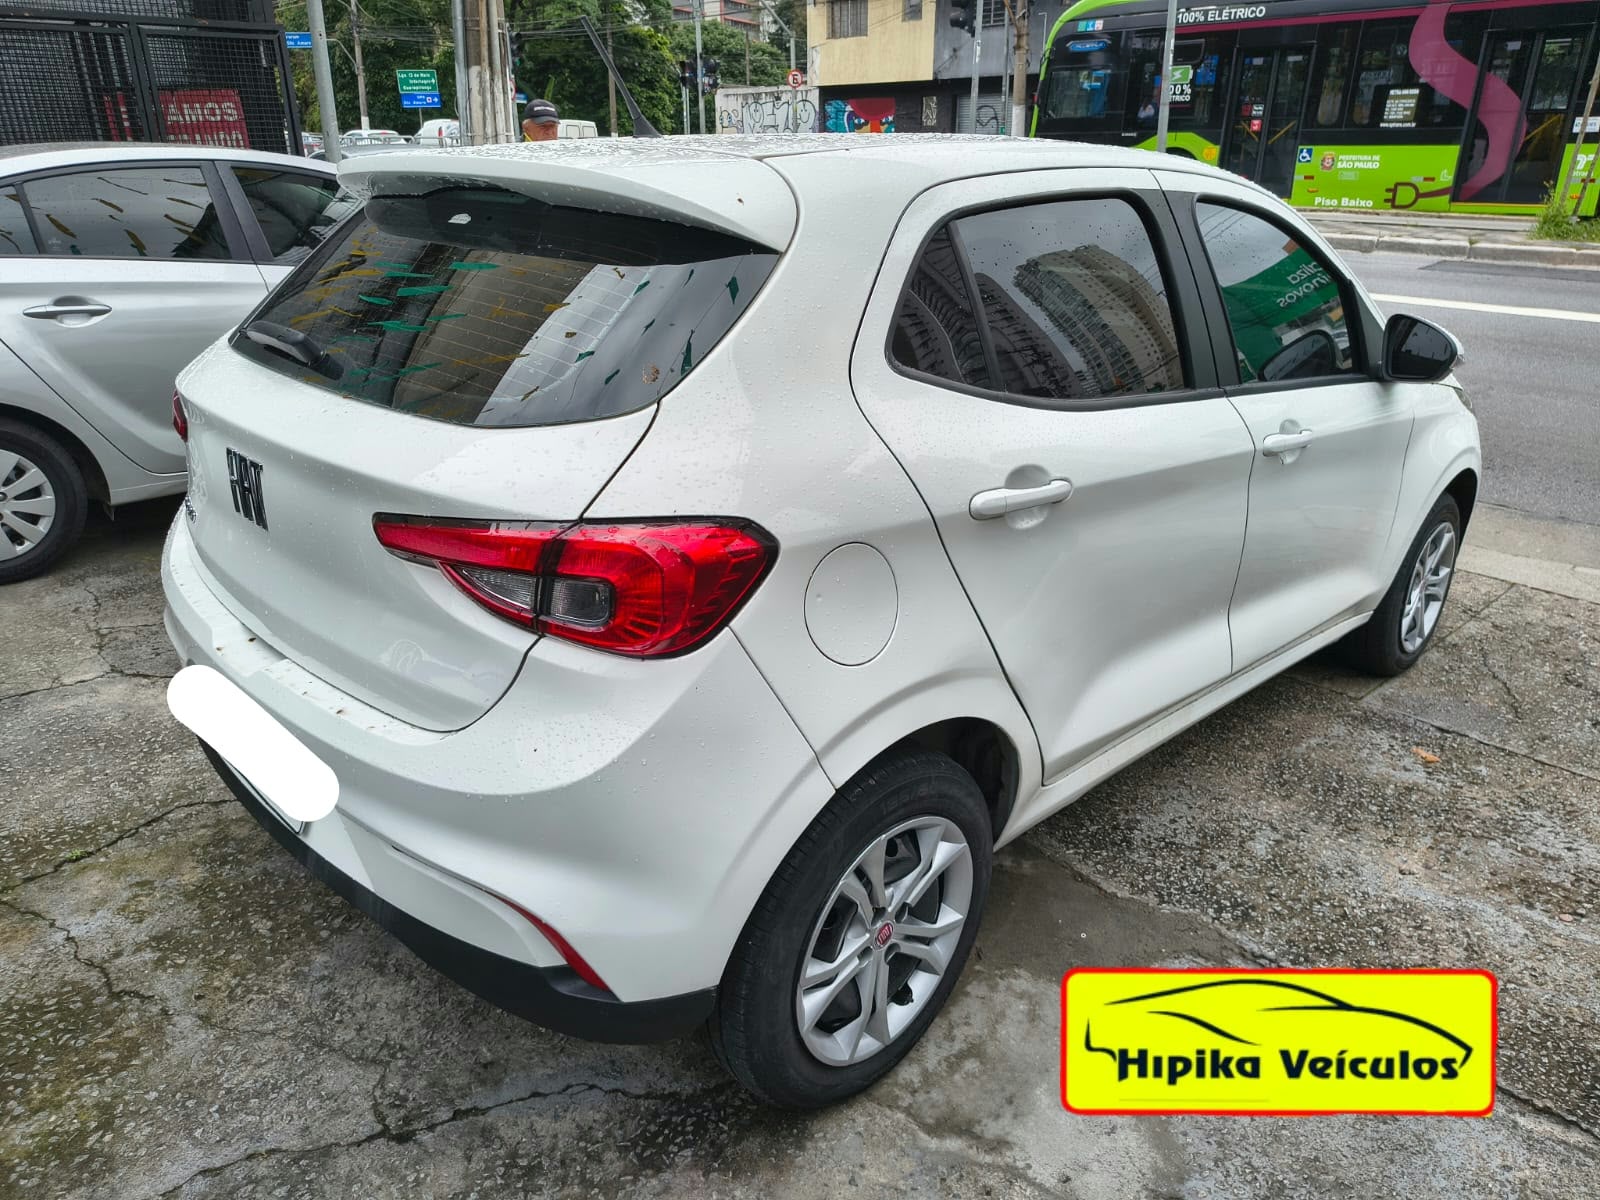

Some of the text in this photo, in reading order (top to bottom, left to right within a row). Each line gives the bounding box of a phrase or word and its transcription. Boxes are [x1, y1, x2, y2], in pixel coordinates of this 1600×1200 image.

[1177, 6, 1266, 23] 100% ELÉTRICO
[167, 102, 239, 124] AMOS
[1337, 161, 1380, 169] SÃO PAULO
[1314, 196, 1373, 207] Piso Baixo
[225, 447, 269, 532] FIAT
